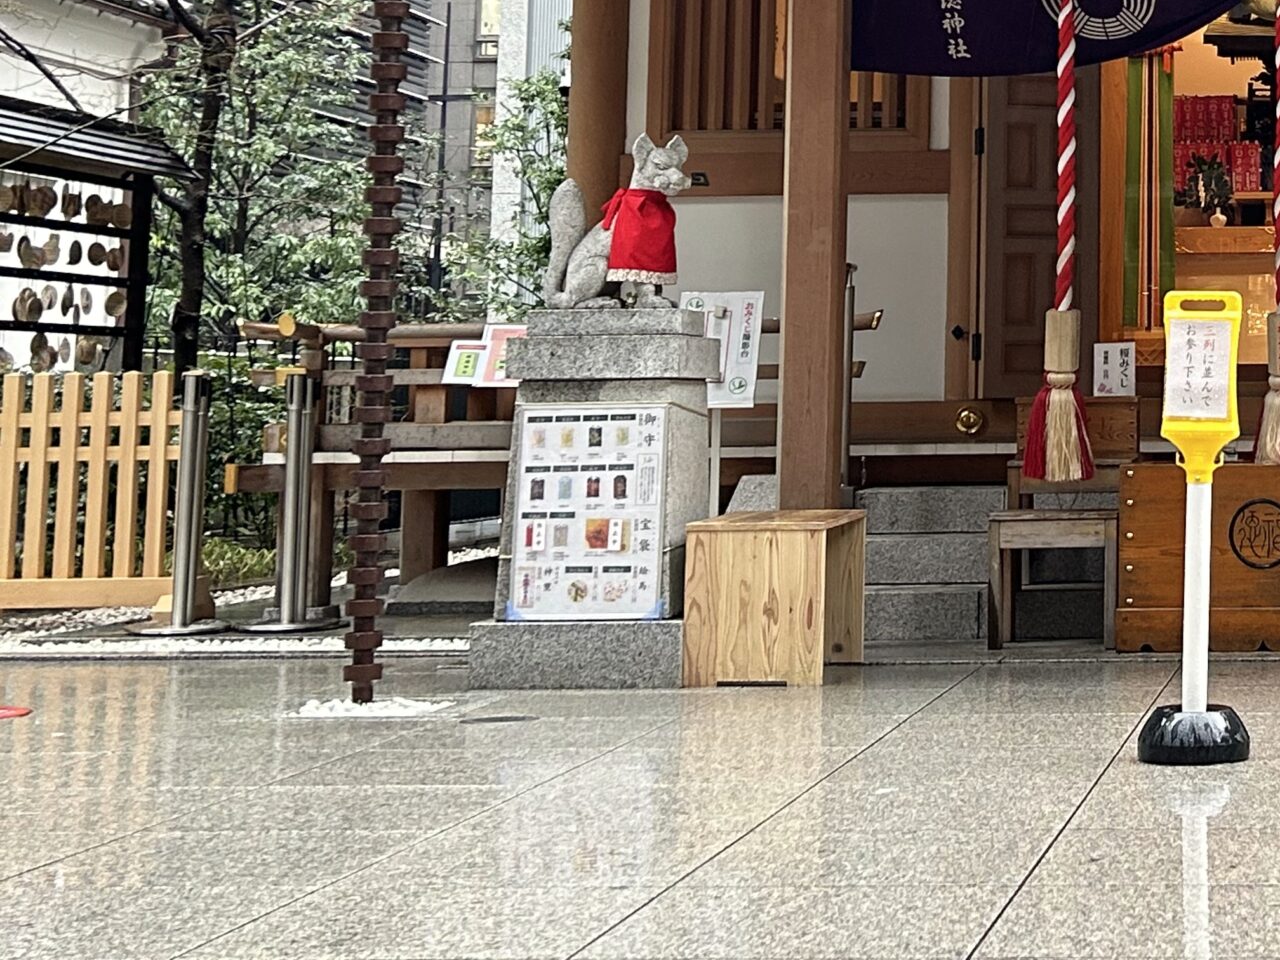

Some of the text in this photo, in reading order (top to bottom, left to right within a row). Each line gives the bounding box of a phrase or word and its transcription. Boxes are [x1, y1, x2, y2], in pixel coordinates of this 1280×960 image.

[1182, 324, 1197, 404] お参り下さい
[1201, 325, 1217, 407] 三列に並んで
